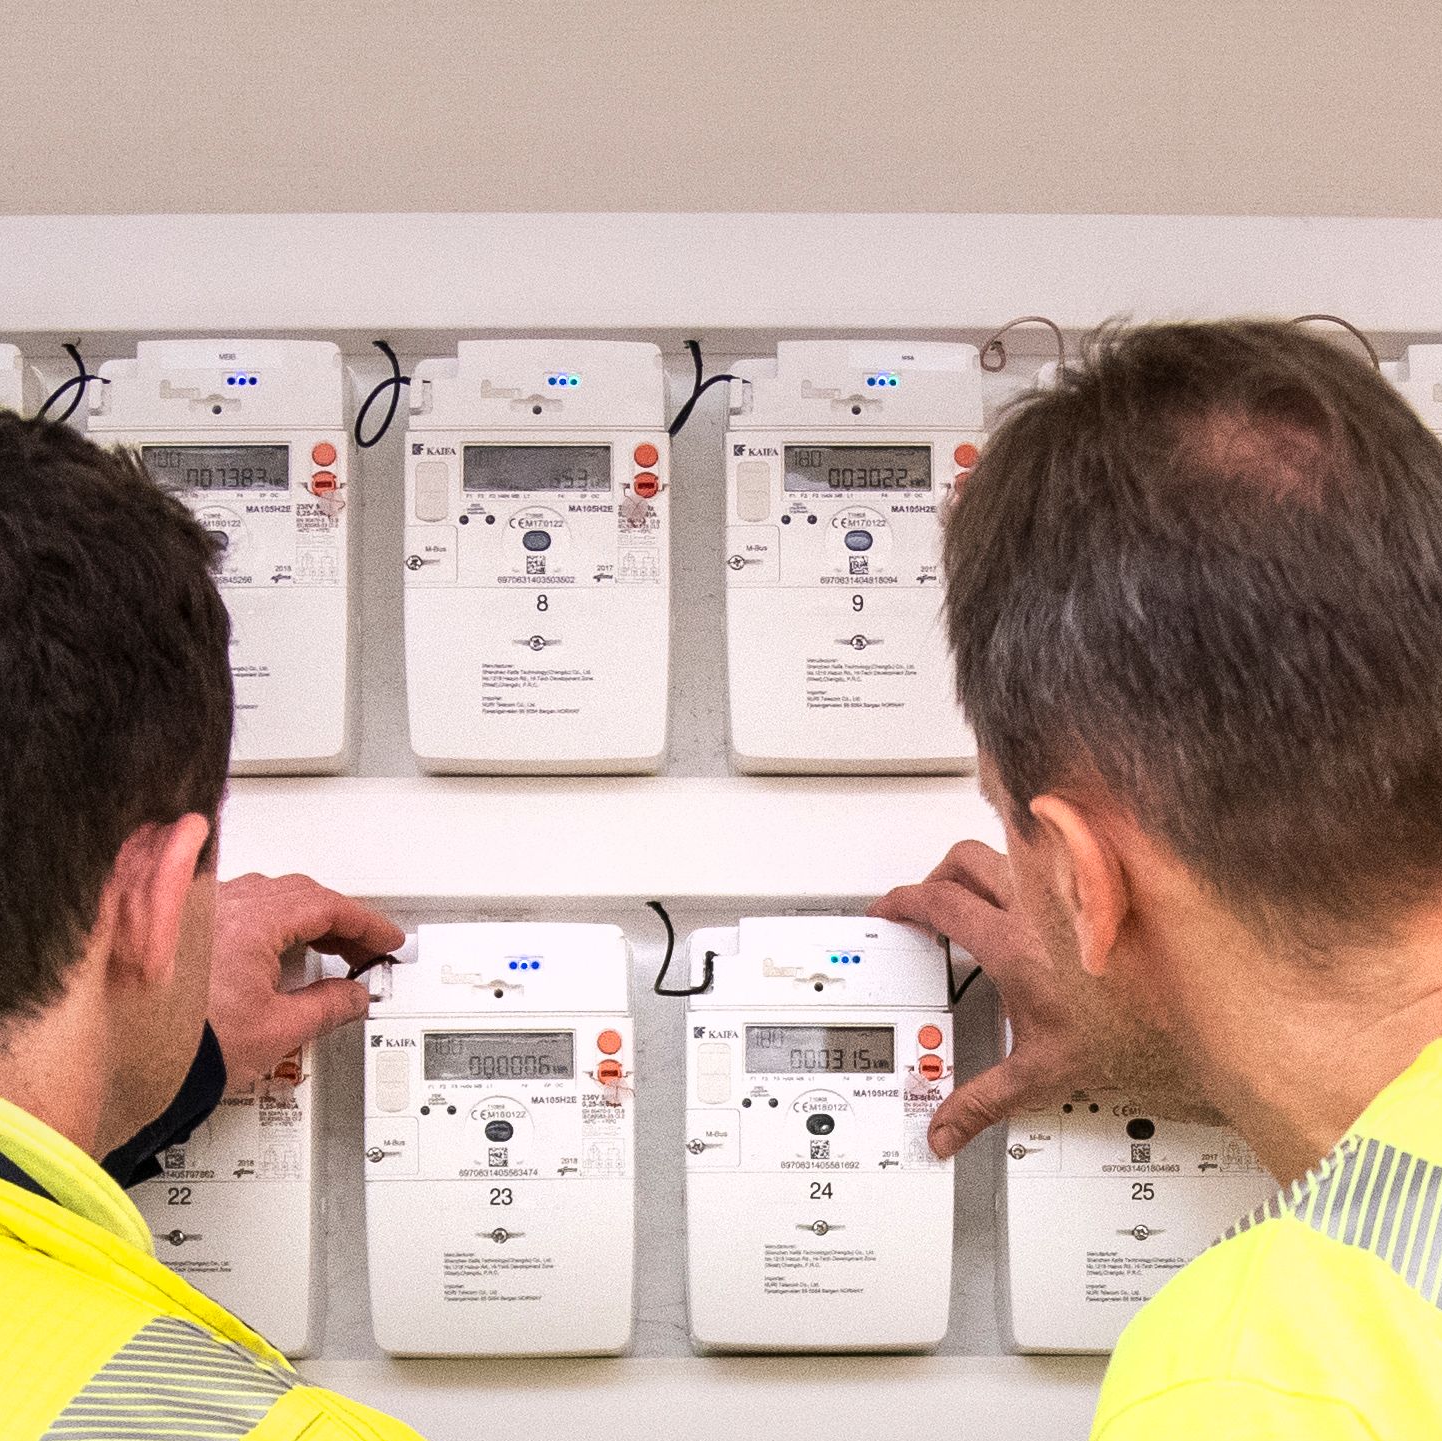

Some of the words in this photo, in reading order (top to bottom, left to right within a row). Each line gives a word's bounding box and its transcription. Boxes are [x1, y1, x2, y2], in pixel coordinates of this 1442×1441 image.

[749, 448, 778, 456] KAIFA
[829, 469, 908, 487] 003022
[537, 594, 548, 612] 8
[852, 594, 864, 612] 9
[386, 1039, 416, 1047] KAIFA
[709, 1031, 738, 1039] KAIFA
[469, 1056, 552, 1076] 000006
[790, 1050, 870, 1069] 000315
[532, 1096, 577, 1104] MA105H2E
[168, 1187, 191, 1205] 22
[490, 1188, 513, 1206] 23
[810, 1182, 833, 1199] 24
[1132, 1183, 1154, 1200] 25
